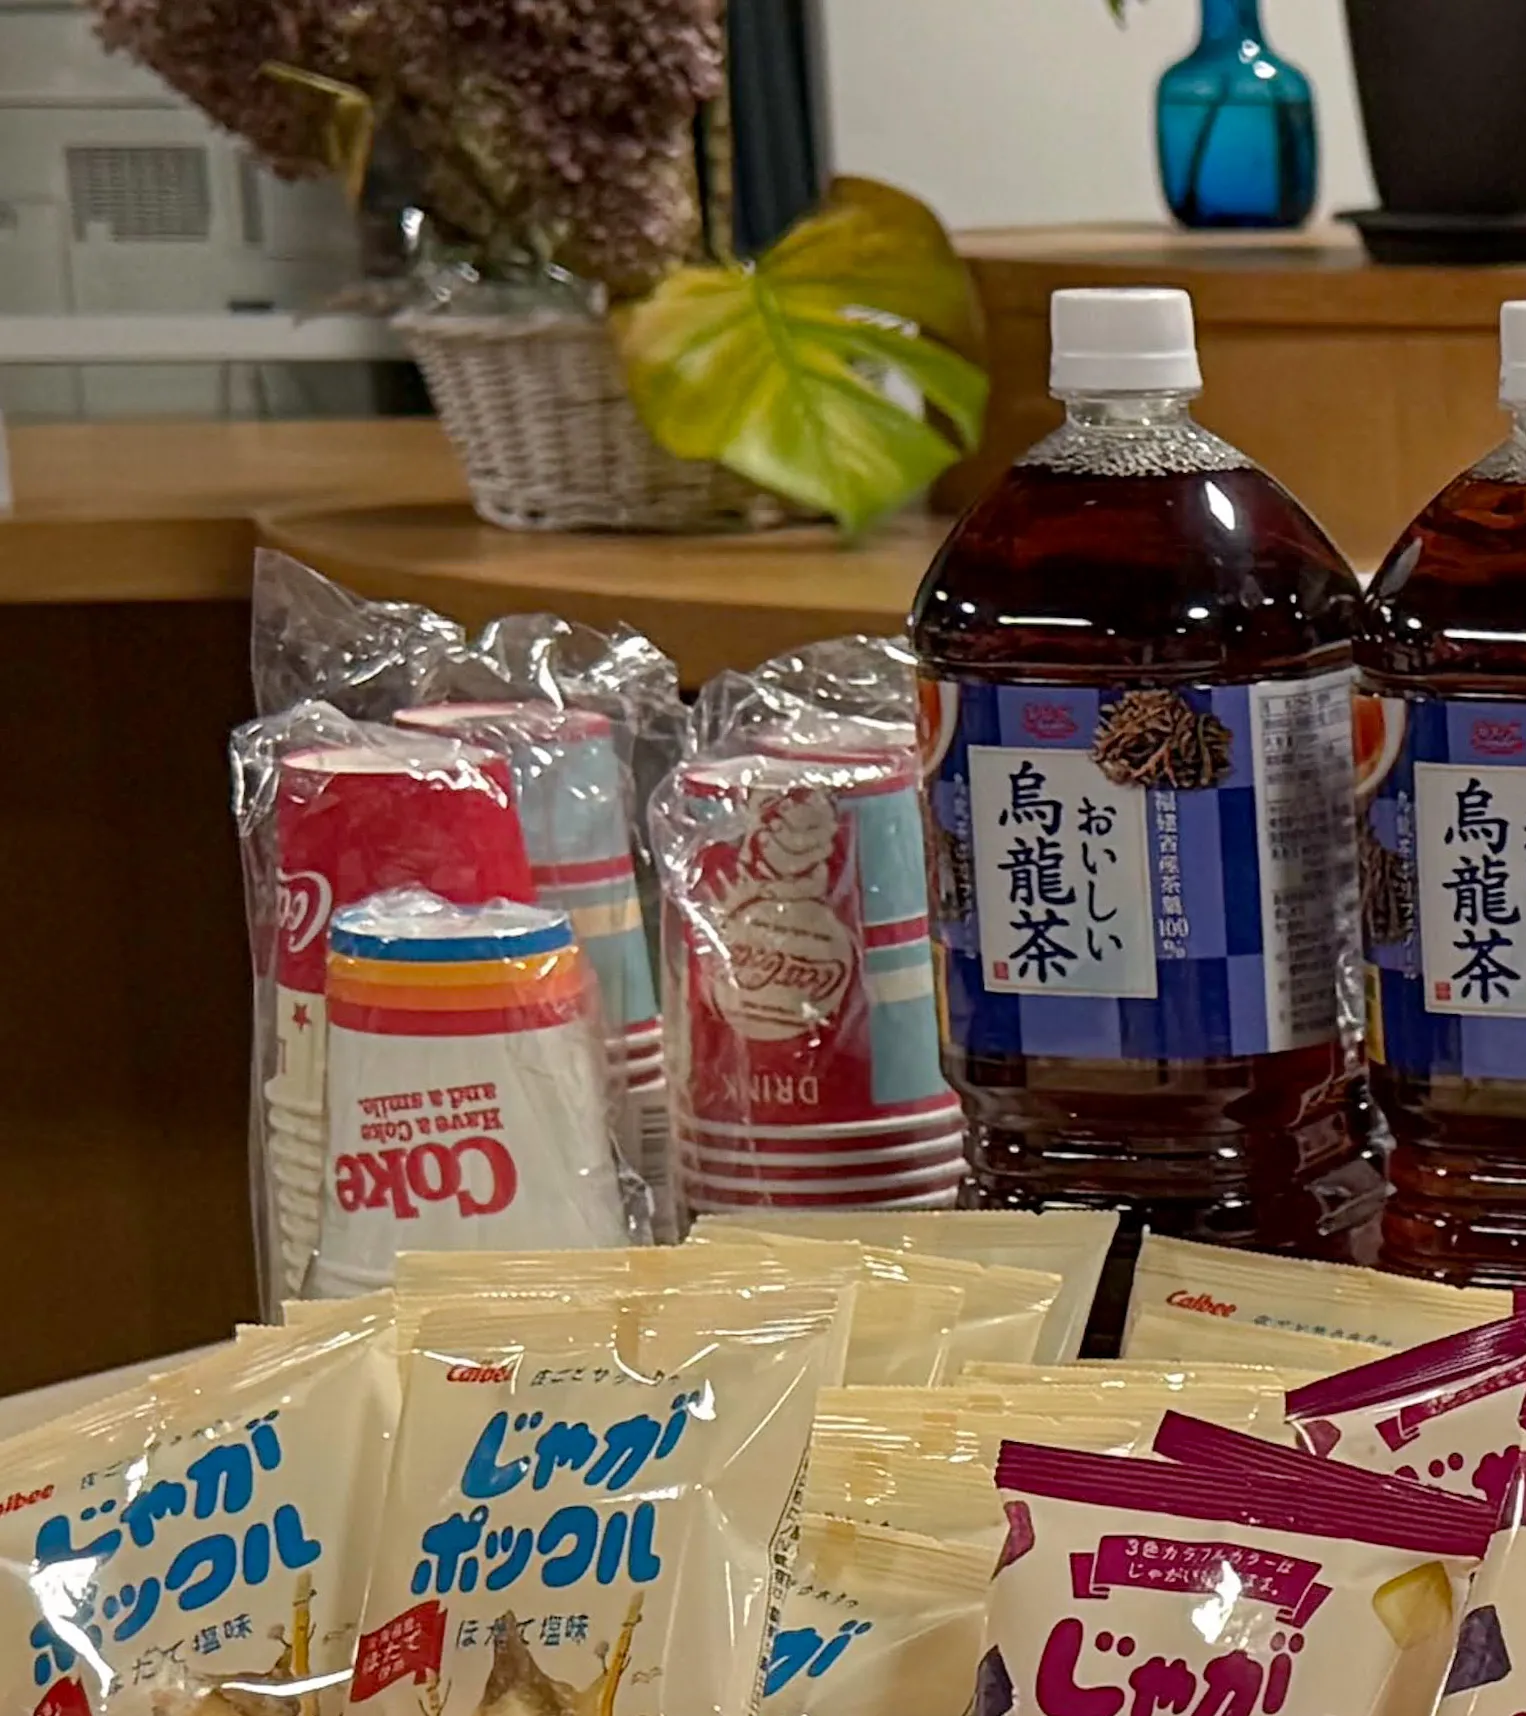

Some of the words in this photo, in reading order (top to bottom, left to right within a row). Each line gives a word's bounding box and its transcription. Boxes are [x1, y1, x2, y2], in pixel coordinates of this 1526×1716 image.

[998, 761, 1077, 983] 烏龍茶
[1078, 796, 1123, 961] おいしい
[1441, 778, 1522, 1004] 烏龍茶
[720, 1073, 819, 1105] DRINK
[334, 1135, 518, 1220] Coke
[1166, 1289, 1237, 1318] Calbee
[460, 1389, 701, 1500] じゃが
[410, 1502, 661, 1597] ポックル
[1125, 1539, 1293, 1575] 3色カラフルカラーは
